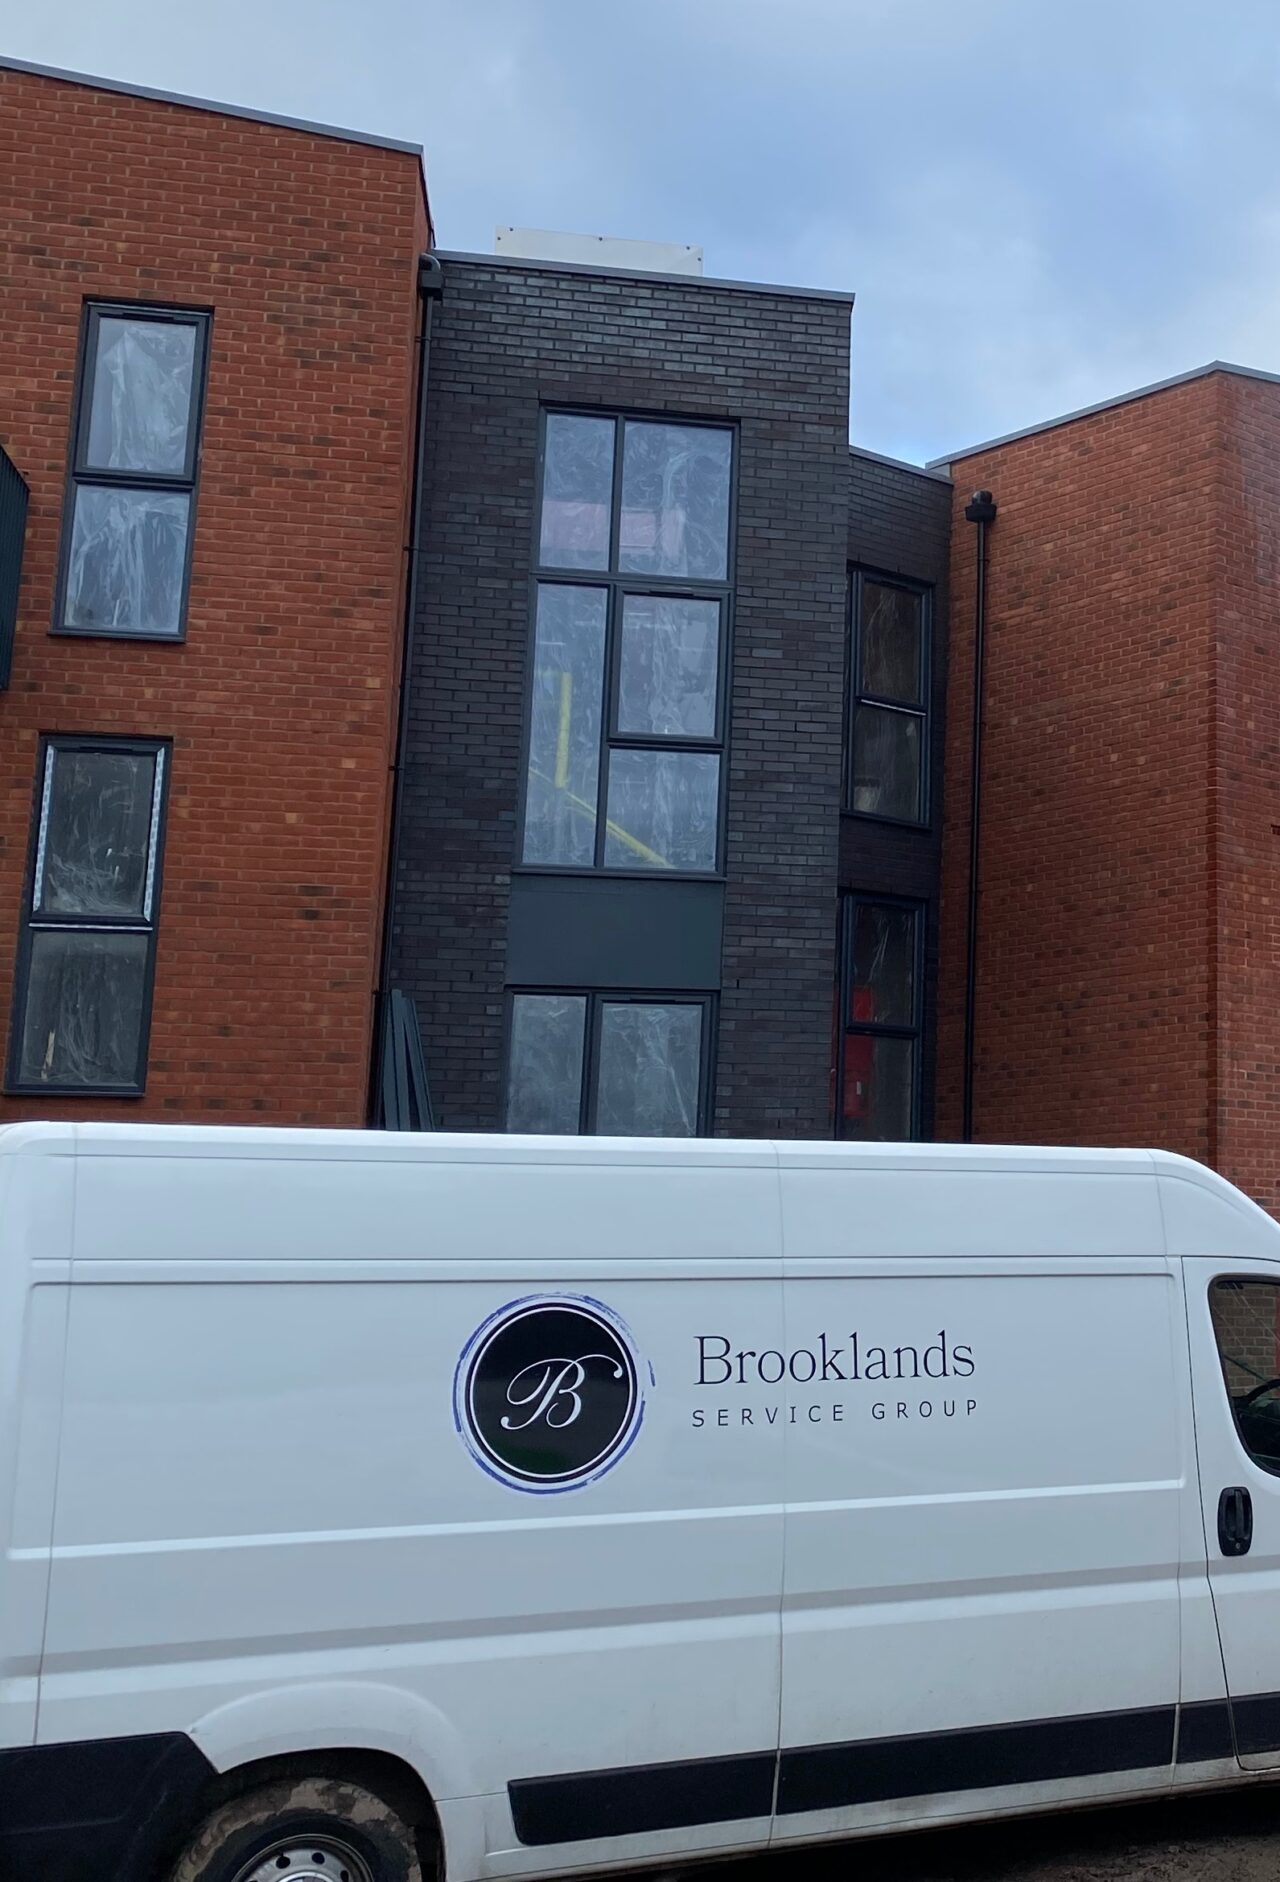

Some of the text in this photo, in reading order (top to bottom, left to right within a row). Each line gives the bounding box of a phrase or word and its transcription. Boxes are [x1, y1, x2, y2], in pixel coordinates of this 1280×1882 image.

[693, 1330, 976, 1386] Brooklands
[500, 1353, 624, 1431] B
[692, 1398, 979, 1428] SERVICE GROUP
